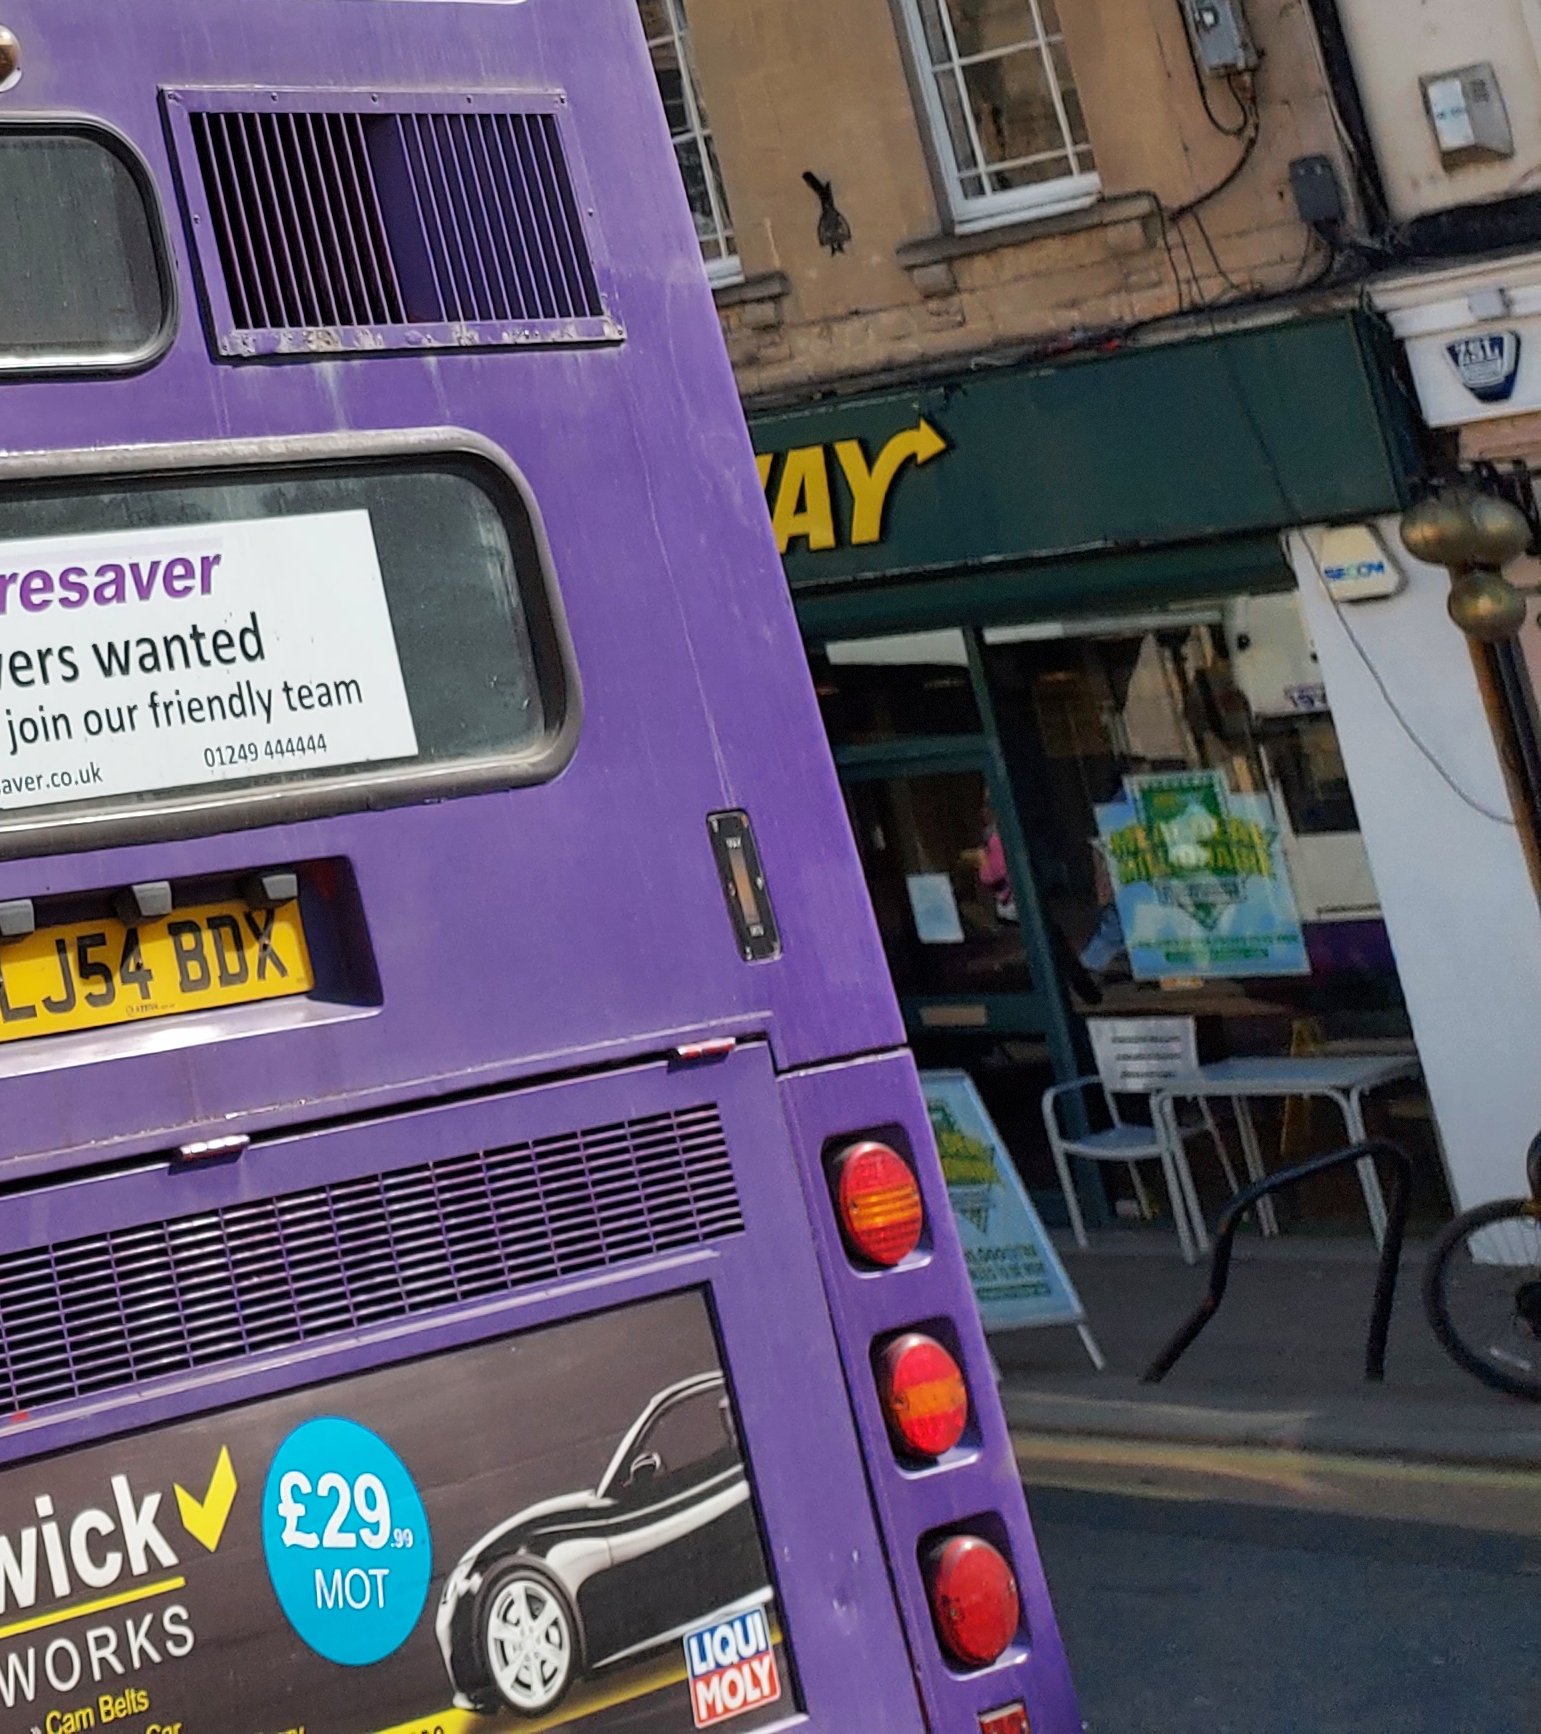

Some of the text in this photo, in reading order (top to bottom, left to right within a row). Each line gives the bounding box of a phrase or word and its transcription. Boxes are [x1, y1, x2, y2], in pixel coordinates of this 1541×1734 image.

[755, 418, 947, 554] AY
[91, 611, 266, 677] wanted
[6, 706, 73, 756] join
[83, 701, 138, 737] our
[148, 680, 273, 732] friendly
[282, 675, 364, 713] team
[204, 732, 328, 769] 01249 444444
[167, 909, 288, 993] BDX
[278, 1470, 414, 1550] £29.99
[315, 1567, 390, 1610] MOT
[689, 1612, 767, 1676] LIQUI
[46, 1688, 150, 1734] Cam Belts
[696, 1656, 772, 1721] MOLY
